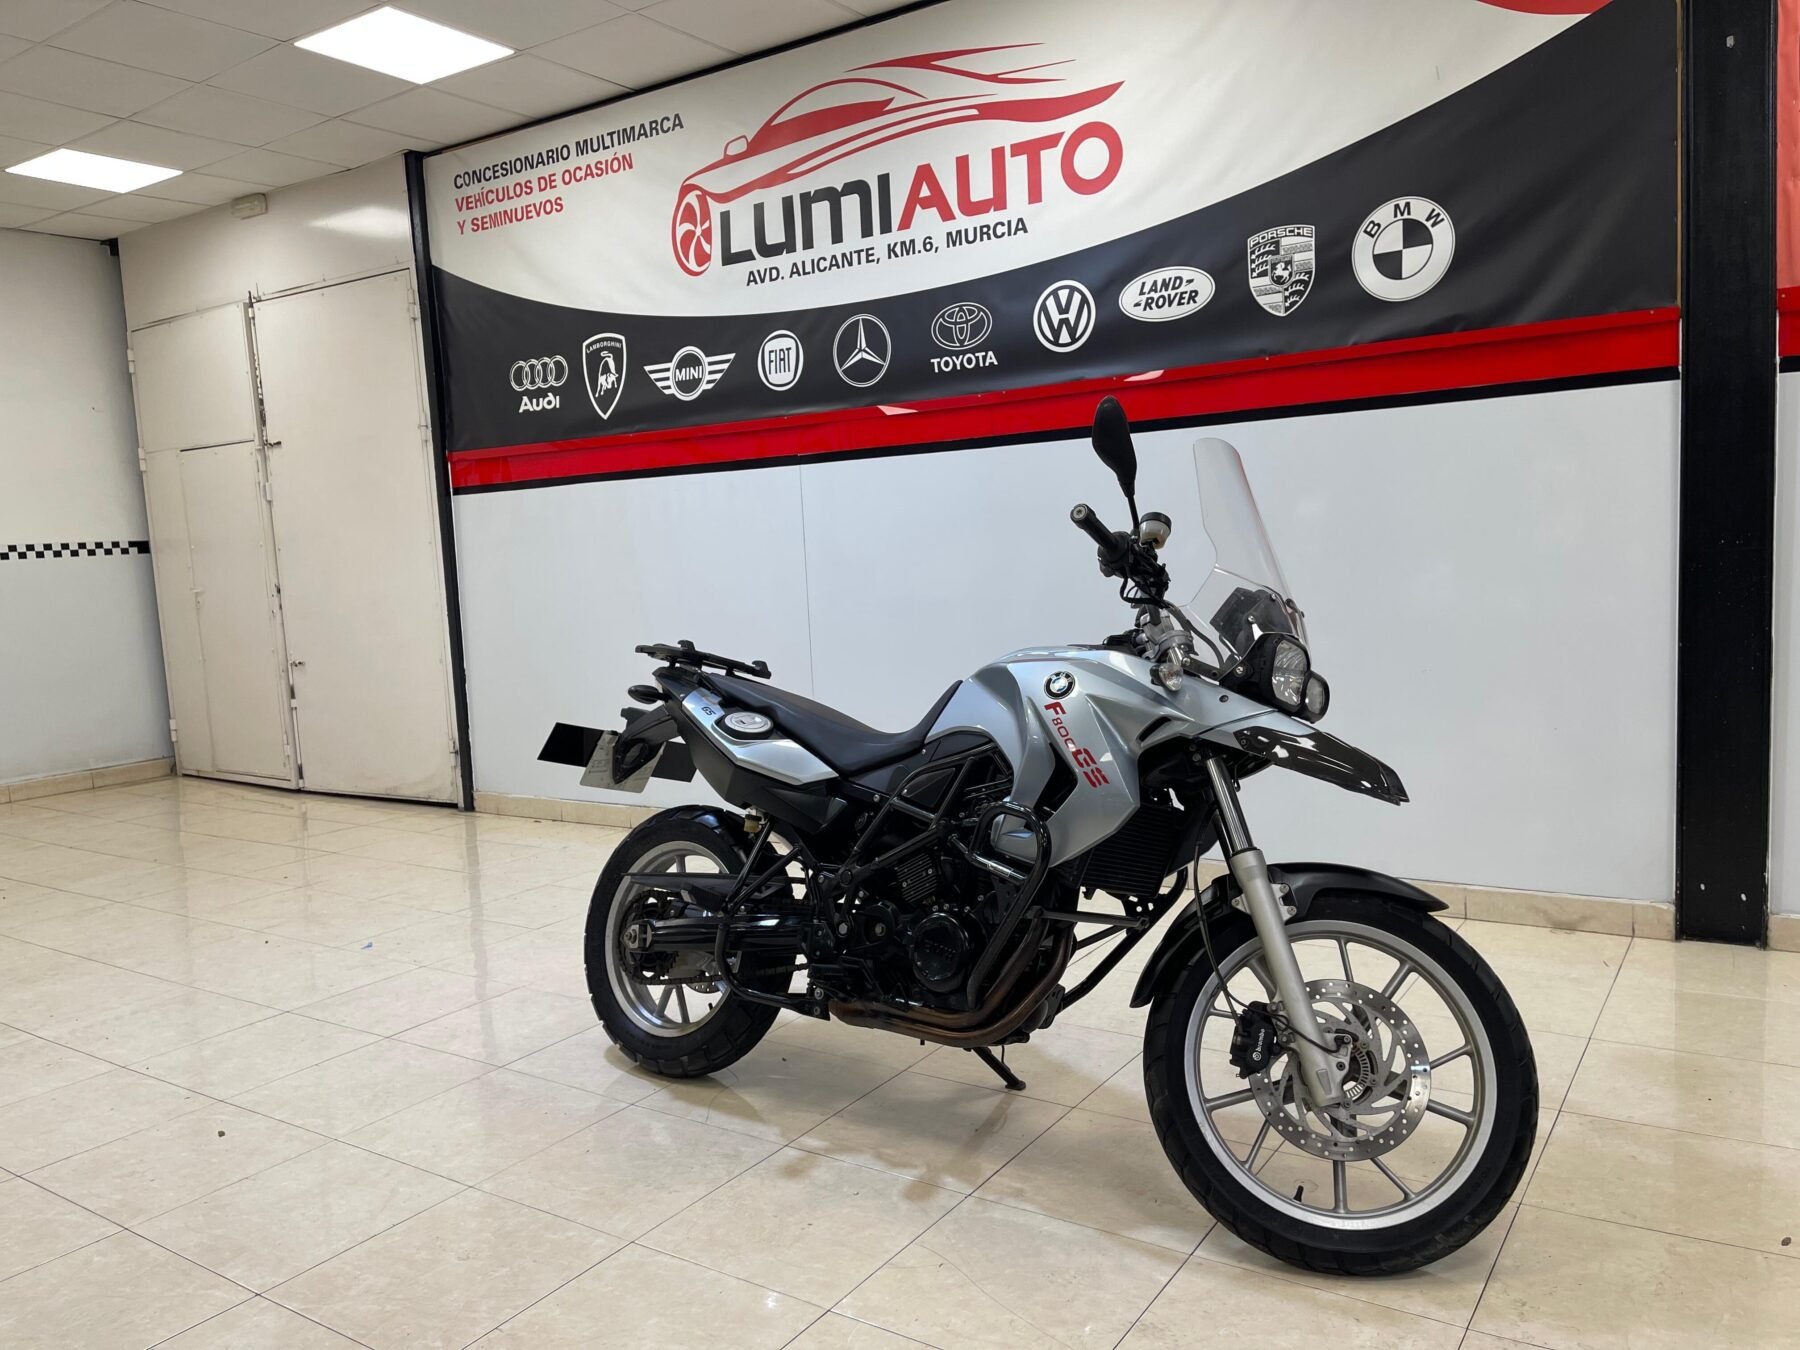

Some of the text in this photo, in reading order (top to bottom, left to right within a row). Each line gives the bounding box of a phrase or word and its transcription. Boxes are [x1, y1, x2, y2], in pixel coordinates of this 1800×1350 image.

[454, 113, 684, 190] CONCESIONARIO MULTIMARCA
[455, 152, 633, 213] VEHÍCULOS DE OCASIÓN
[457, 196, 564, 235] Y SEMINUEVOS
[1363, 201, 1445, 239] BMW
[1250, 226, 1313, 248] PORSCHE
[746, 217, 1028, 286] AVD. ALICANTE, KM.6, MURCIA
[1139, 275, 1184, 296] LAND
[1142, 289, 1199, 311] ROVER
[586, 341, 622, 354] LAMBORGHINI
[768, 347, 792, 375] FIAT
[930, 350, 998, 373] TOYOTA
[675, 365, 703, 382] MINI
[519, 392, 560, 413] Audi
